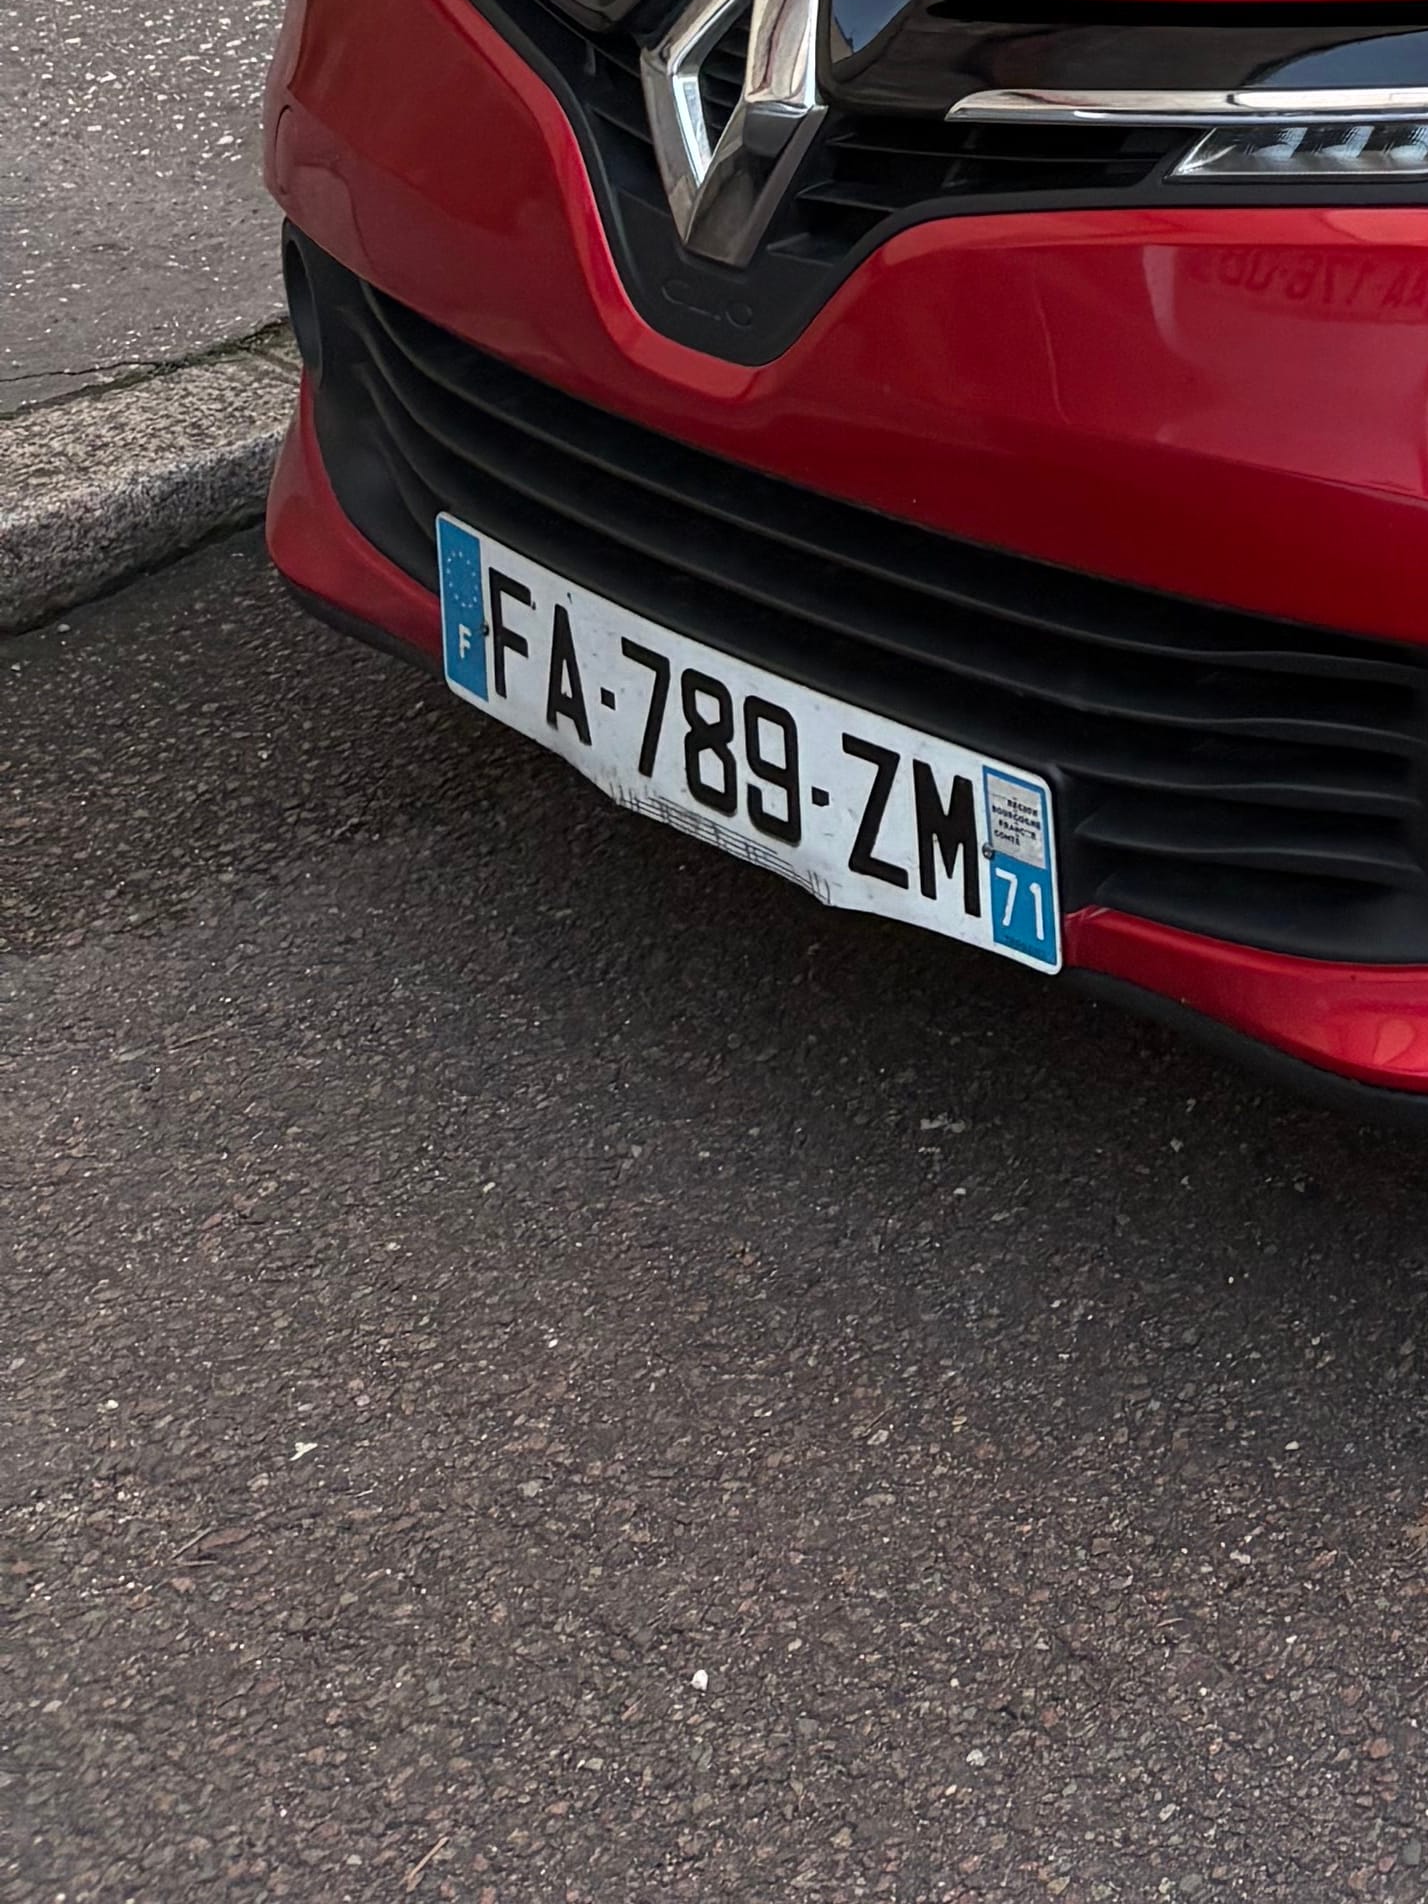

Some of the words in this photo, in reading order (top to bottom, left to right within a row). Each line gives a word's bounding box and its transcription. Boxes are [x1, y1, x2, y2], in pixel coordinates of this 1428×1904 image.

[660, 279, 753, 329] CO
[459, 623, 472, 659] F
[489, 566, 981, 918] FA-789-ZM
[995, 867, 1045, 941] 71
